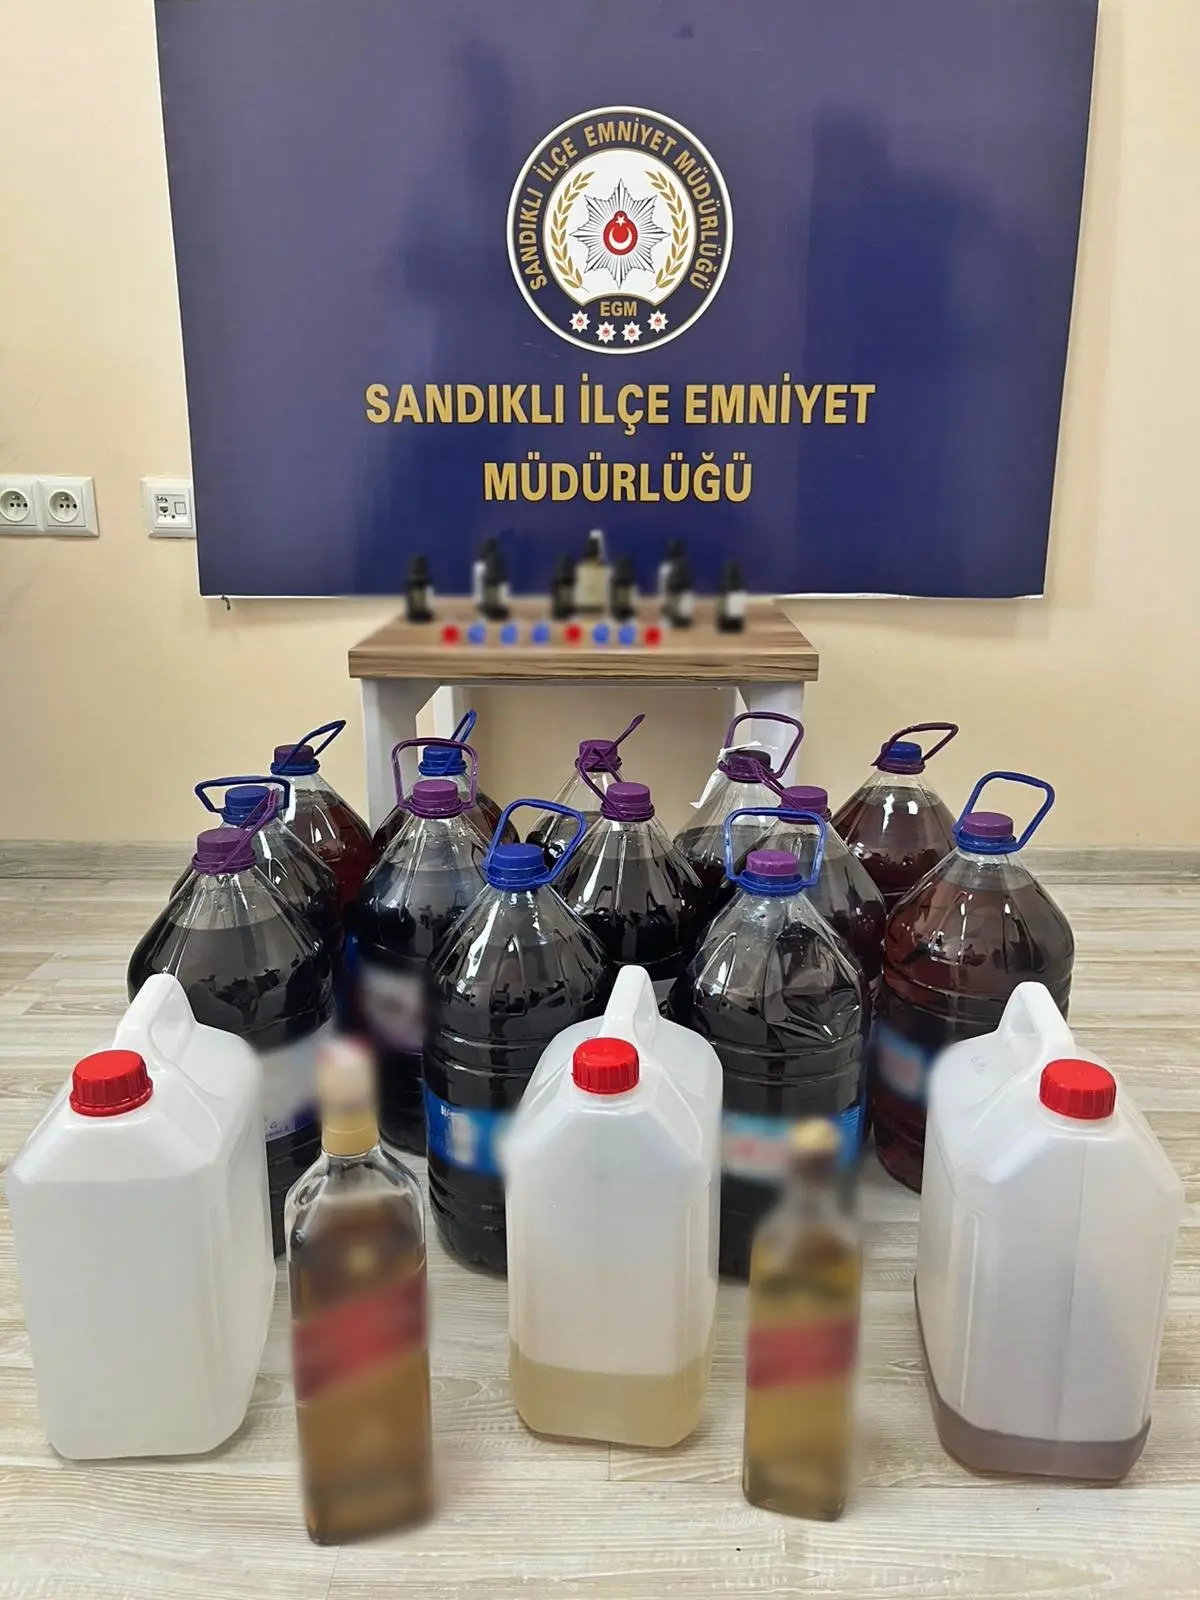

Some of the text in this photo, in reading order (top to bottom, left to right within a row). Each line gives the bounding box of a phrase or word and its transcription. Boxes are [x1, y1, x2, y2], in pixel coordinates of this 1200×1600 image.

[519, 117, 722, 291] SANDIKLI İLÇE EMNİYET MÜDÜRLÜĞÜ
[600, 301, 637, 317] EGM
[366, 372, 876, 436] SANDIKLI İLÇE EMNİYET
[484, 452, 752, 502] MÜDÜRLÜĞÜ
